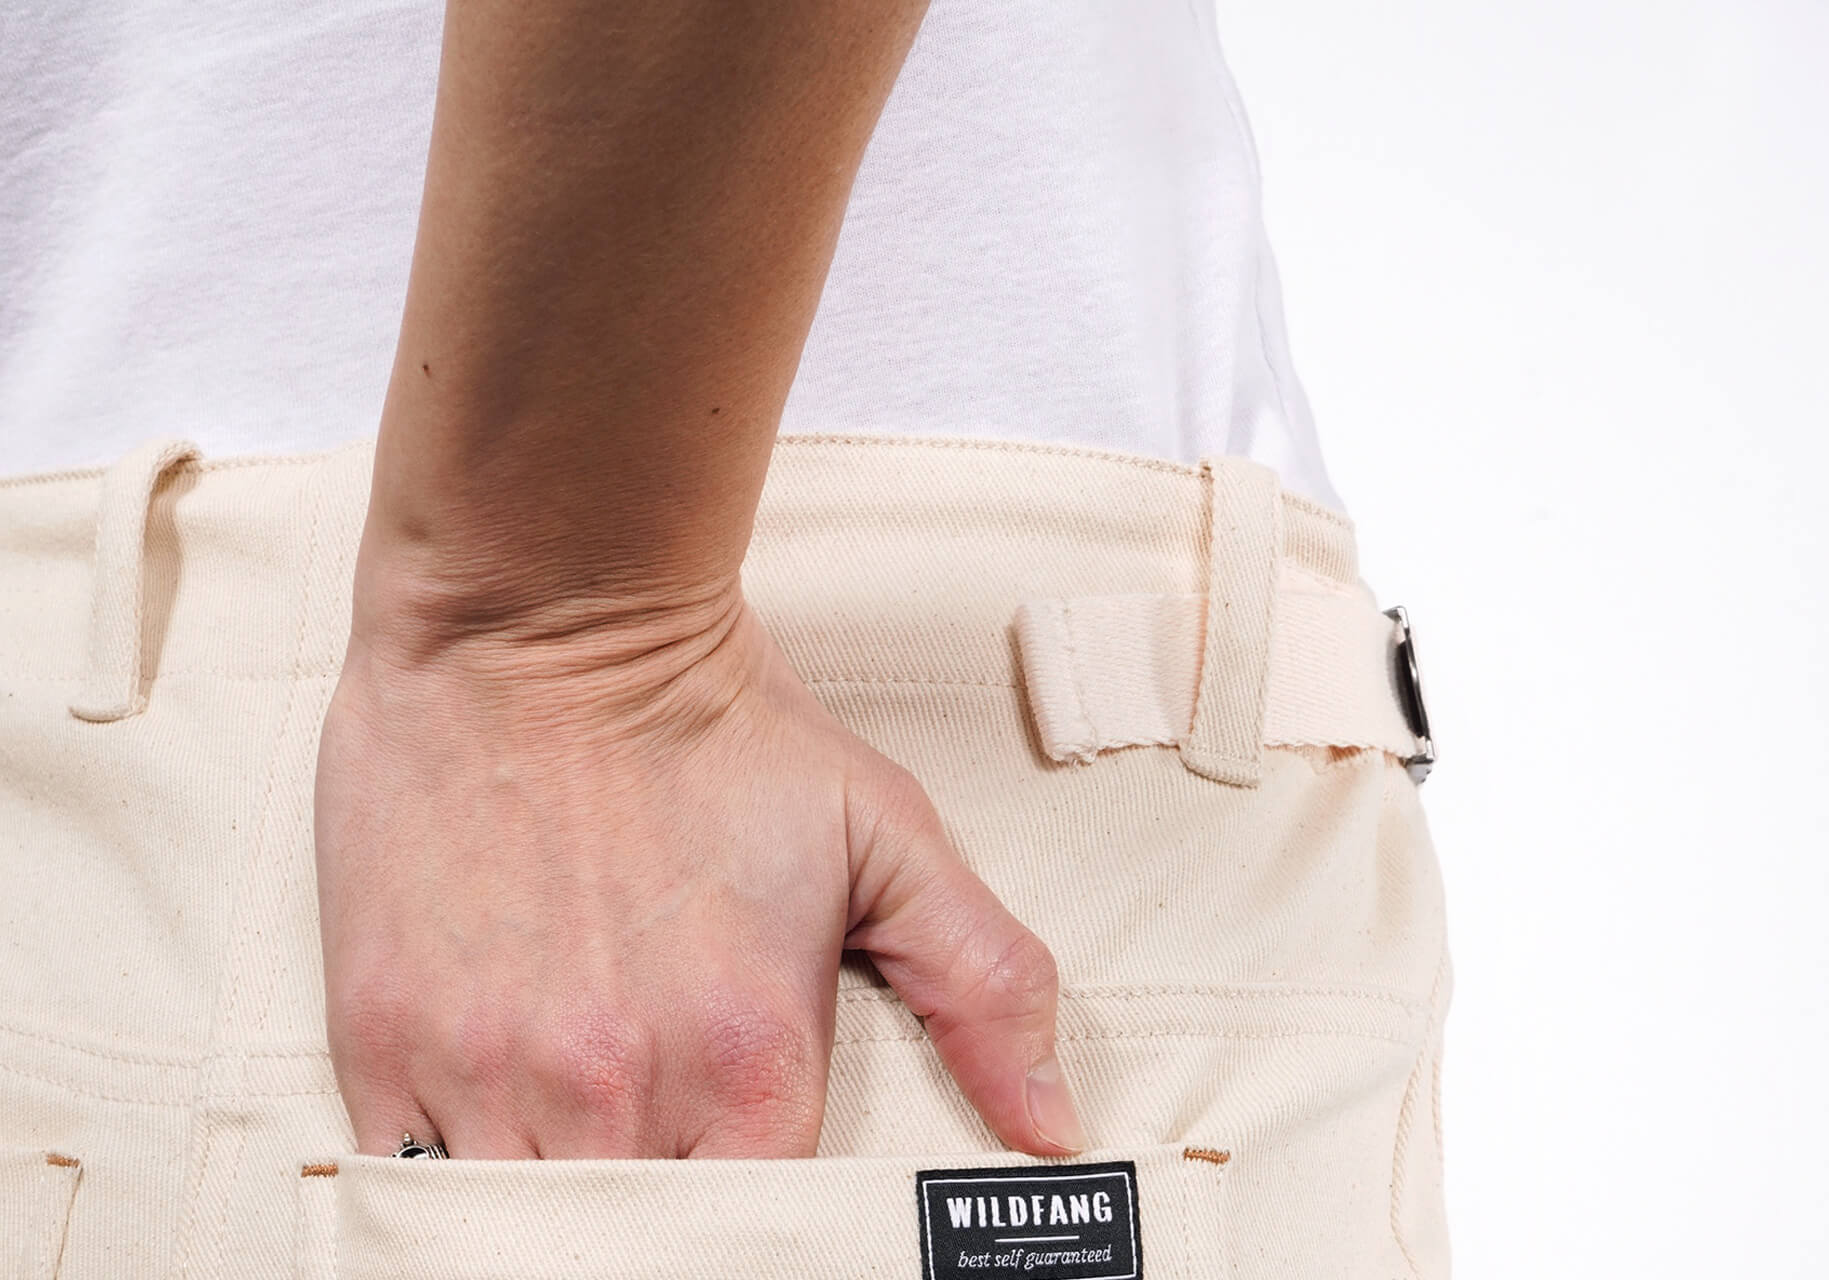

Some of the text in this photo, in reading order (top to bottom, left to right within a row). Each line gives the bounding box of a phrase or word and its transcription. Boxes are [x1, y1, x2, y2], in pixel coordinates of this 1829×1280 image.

[946, 1191, 1113, 1229] WILDFANG
[957, 1244, 1112, 1270] best self guaranteed
